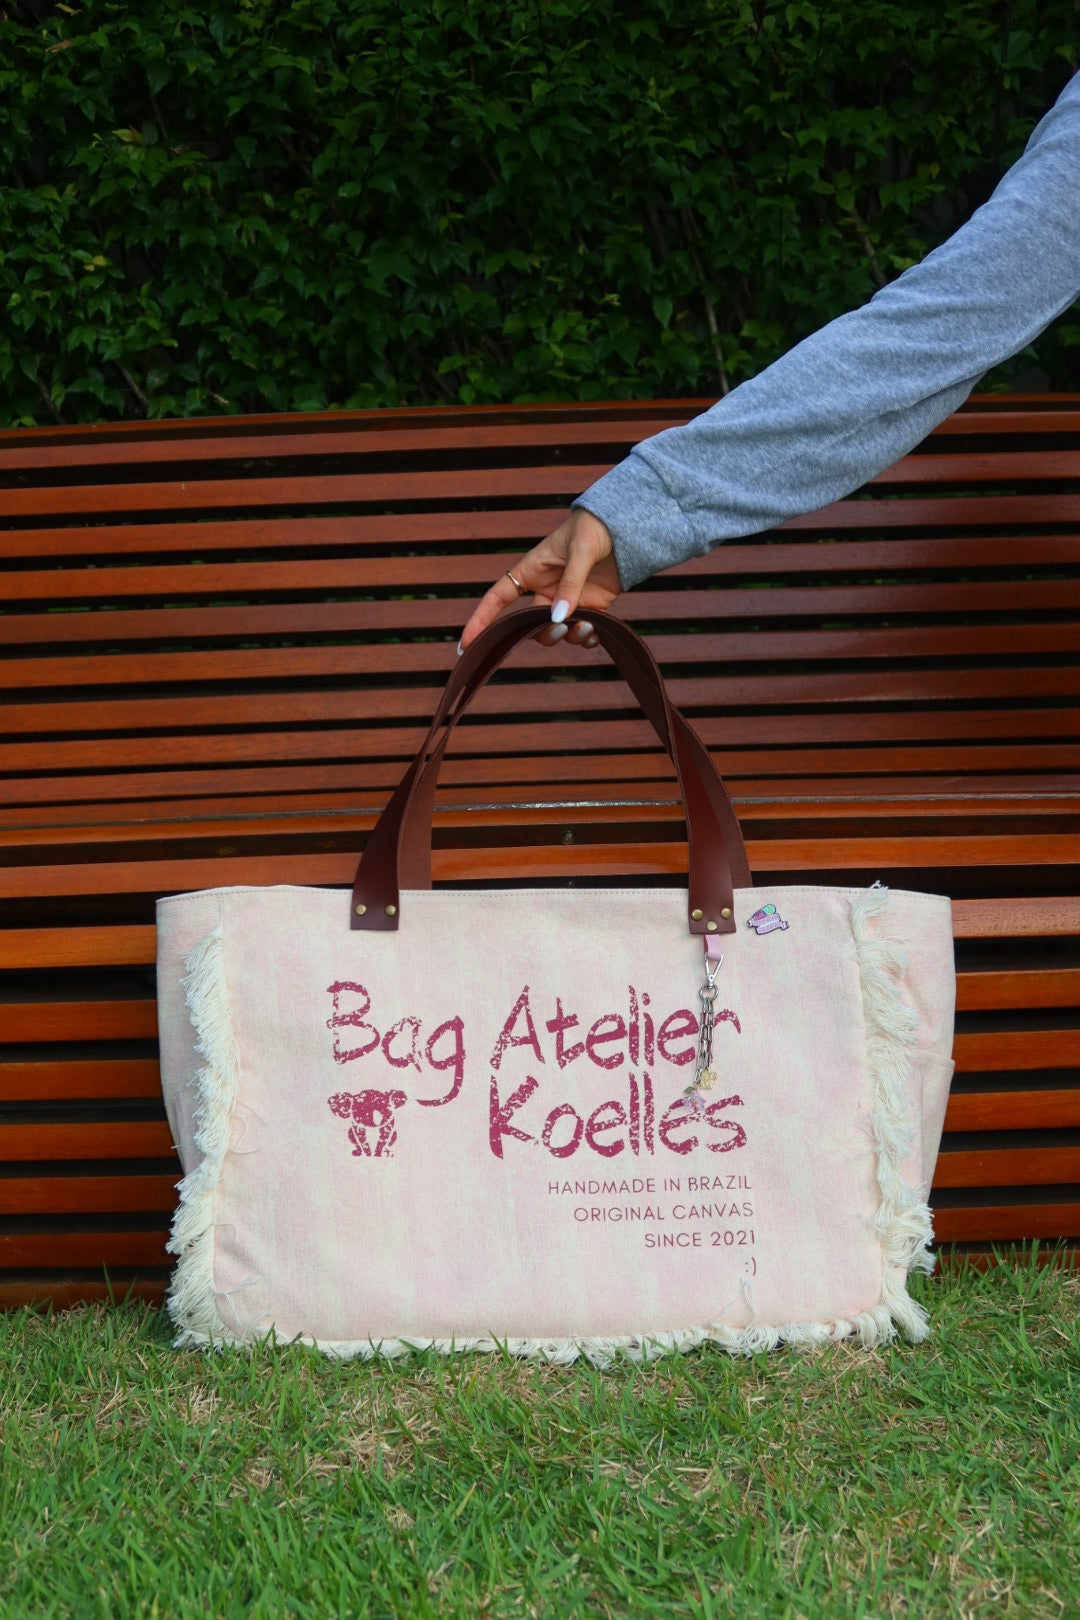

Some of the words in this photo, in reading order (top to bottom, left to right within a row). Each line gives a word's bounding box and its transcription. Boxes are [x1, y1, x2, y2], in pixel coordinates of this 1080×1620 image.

[326, 980, 466, 1107] Bag
[489, 985, 742, 1070] Atelier
[489, 1071, 748, 1159] Koelles
[548, 1178, 656, 1195] HANDMADE
[664, 1177, 681, 1192] IN
[688, 1175, 753, 1191] BRAZIL
[573, 1206, 665, 1222] ORIGINAL
[672, 1202, 754, 1220] CANVAS
[644, 1231, 702, 1248] SINCE
[710, 1229, 755, 1247] 2021
